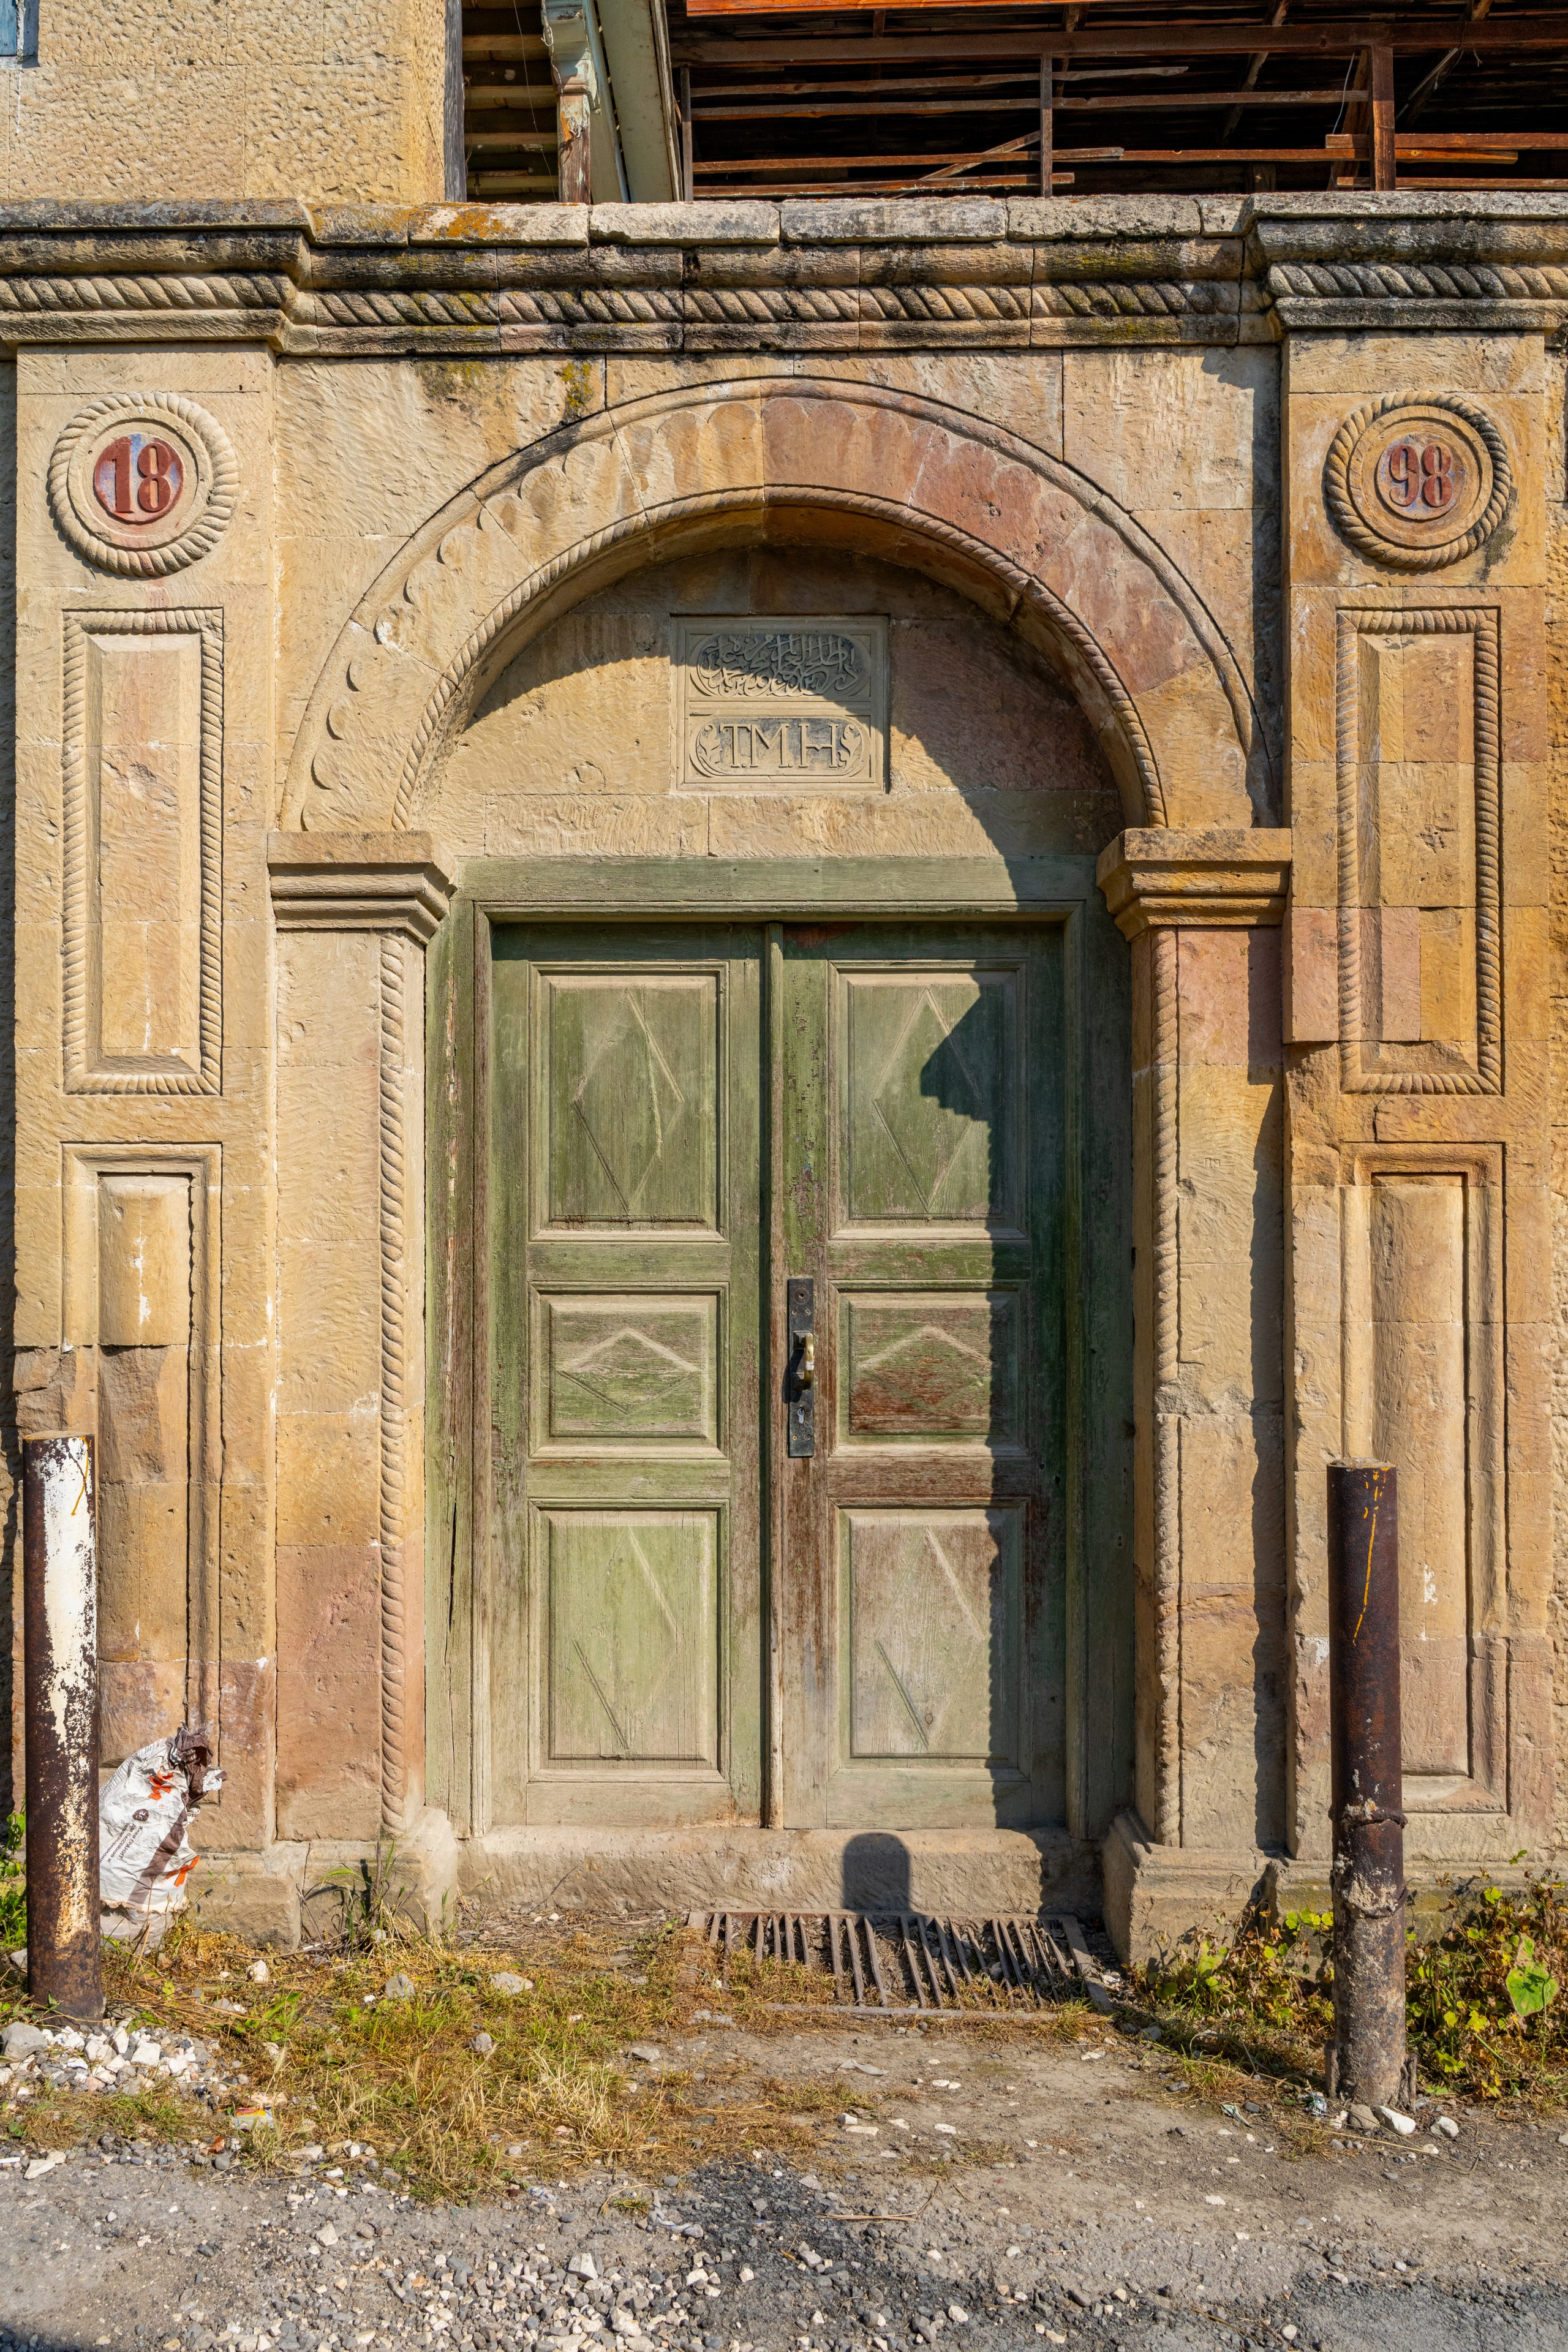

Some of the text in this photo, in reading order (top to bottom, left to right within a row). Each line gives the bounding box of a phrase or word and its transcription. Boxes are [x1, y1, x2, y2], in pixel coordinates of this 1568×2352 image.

[101, 436, 170, 513] 18
[1390, 442, 1452, 507] 98
[118, 1838, 134, 1859] ГРАНИТ
